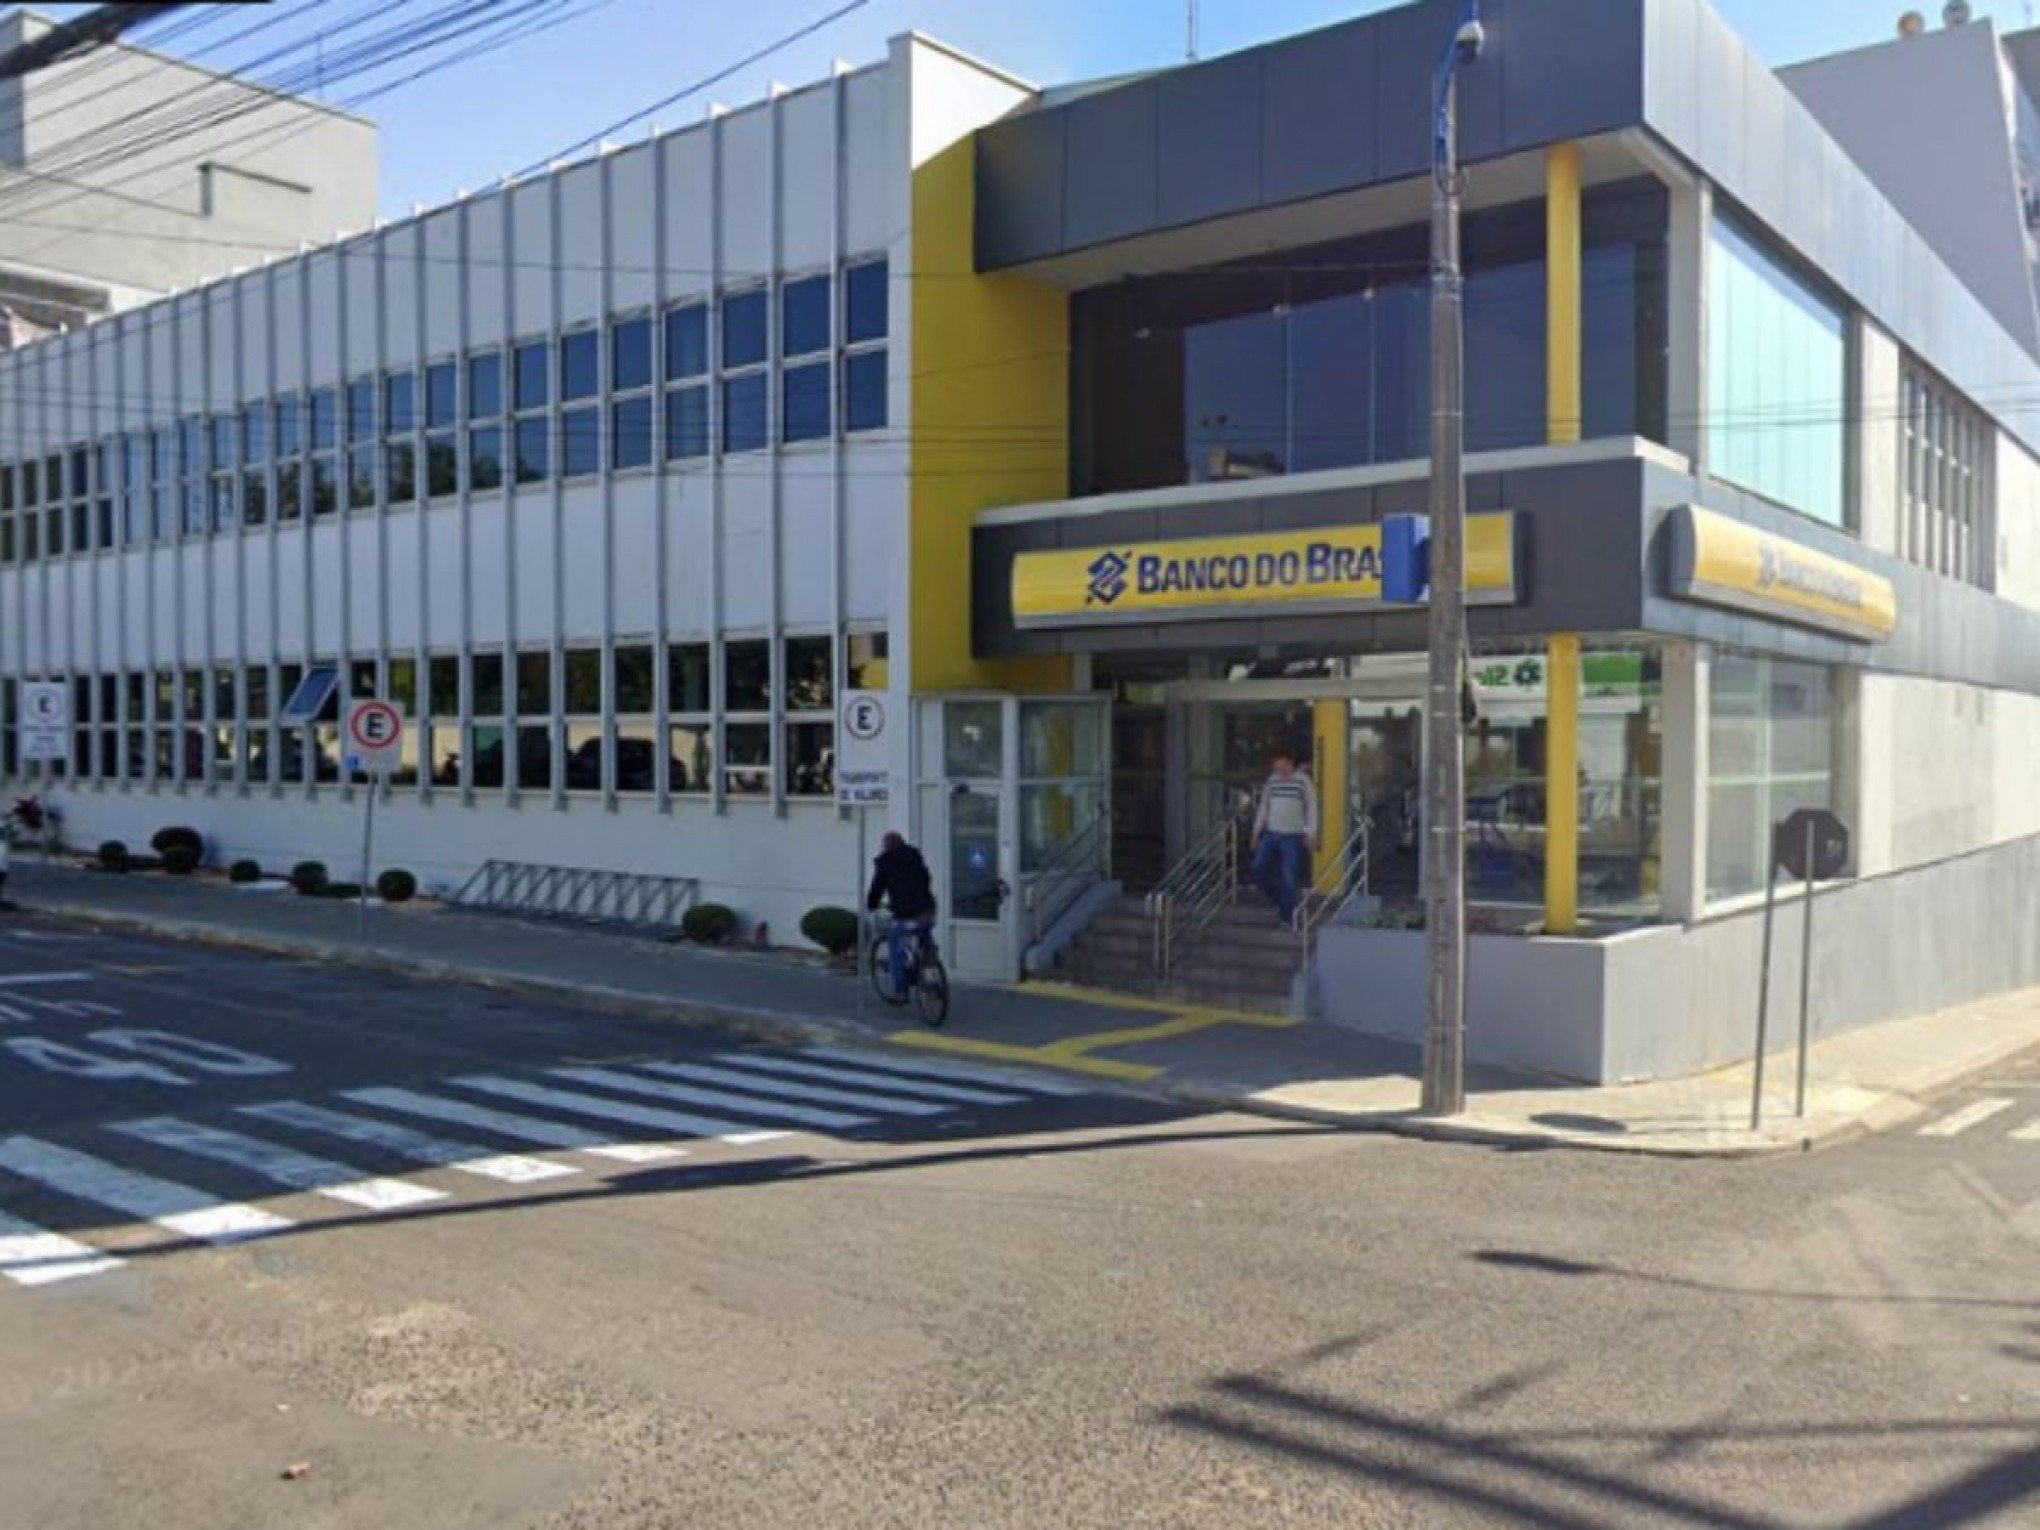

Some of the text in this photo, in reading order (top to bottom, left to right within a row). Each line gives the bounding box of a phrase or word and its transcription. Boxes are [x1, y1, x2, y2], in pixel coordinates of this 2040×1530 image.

[1138, 542, 1383, 593] BANCO DO BRA
[366, 712, 384, 738] E
[857, 705, 873, 730] E
